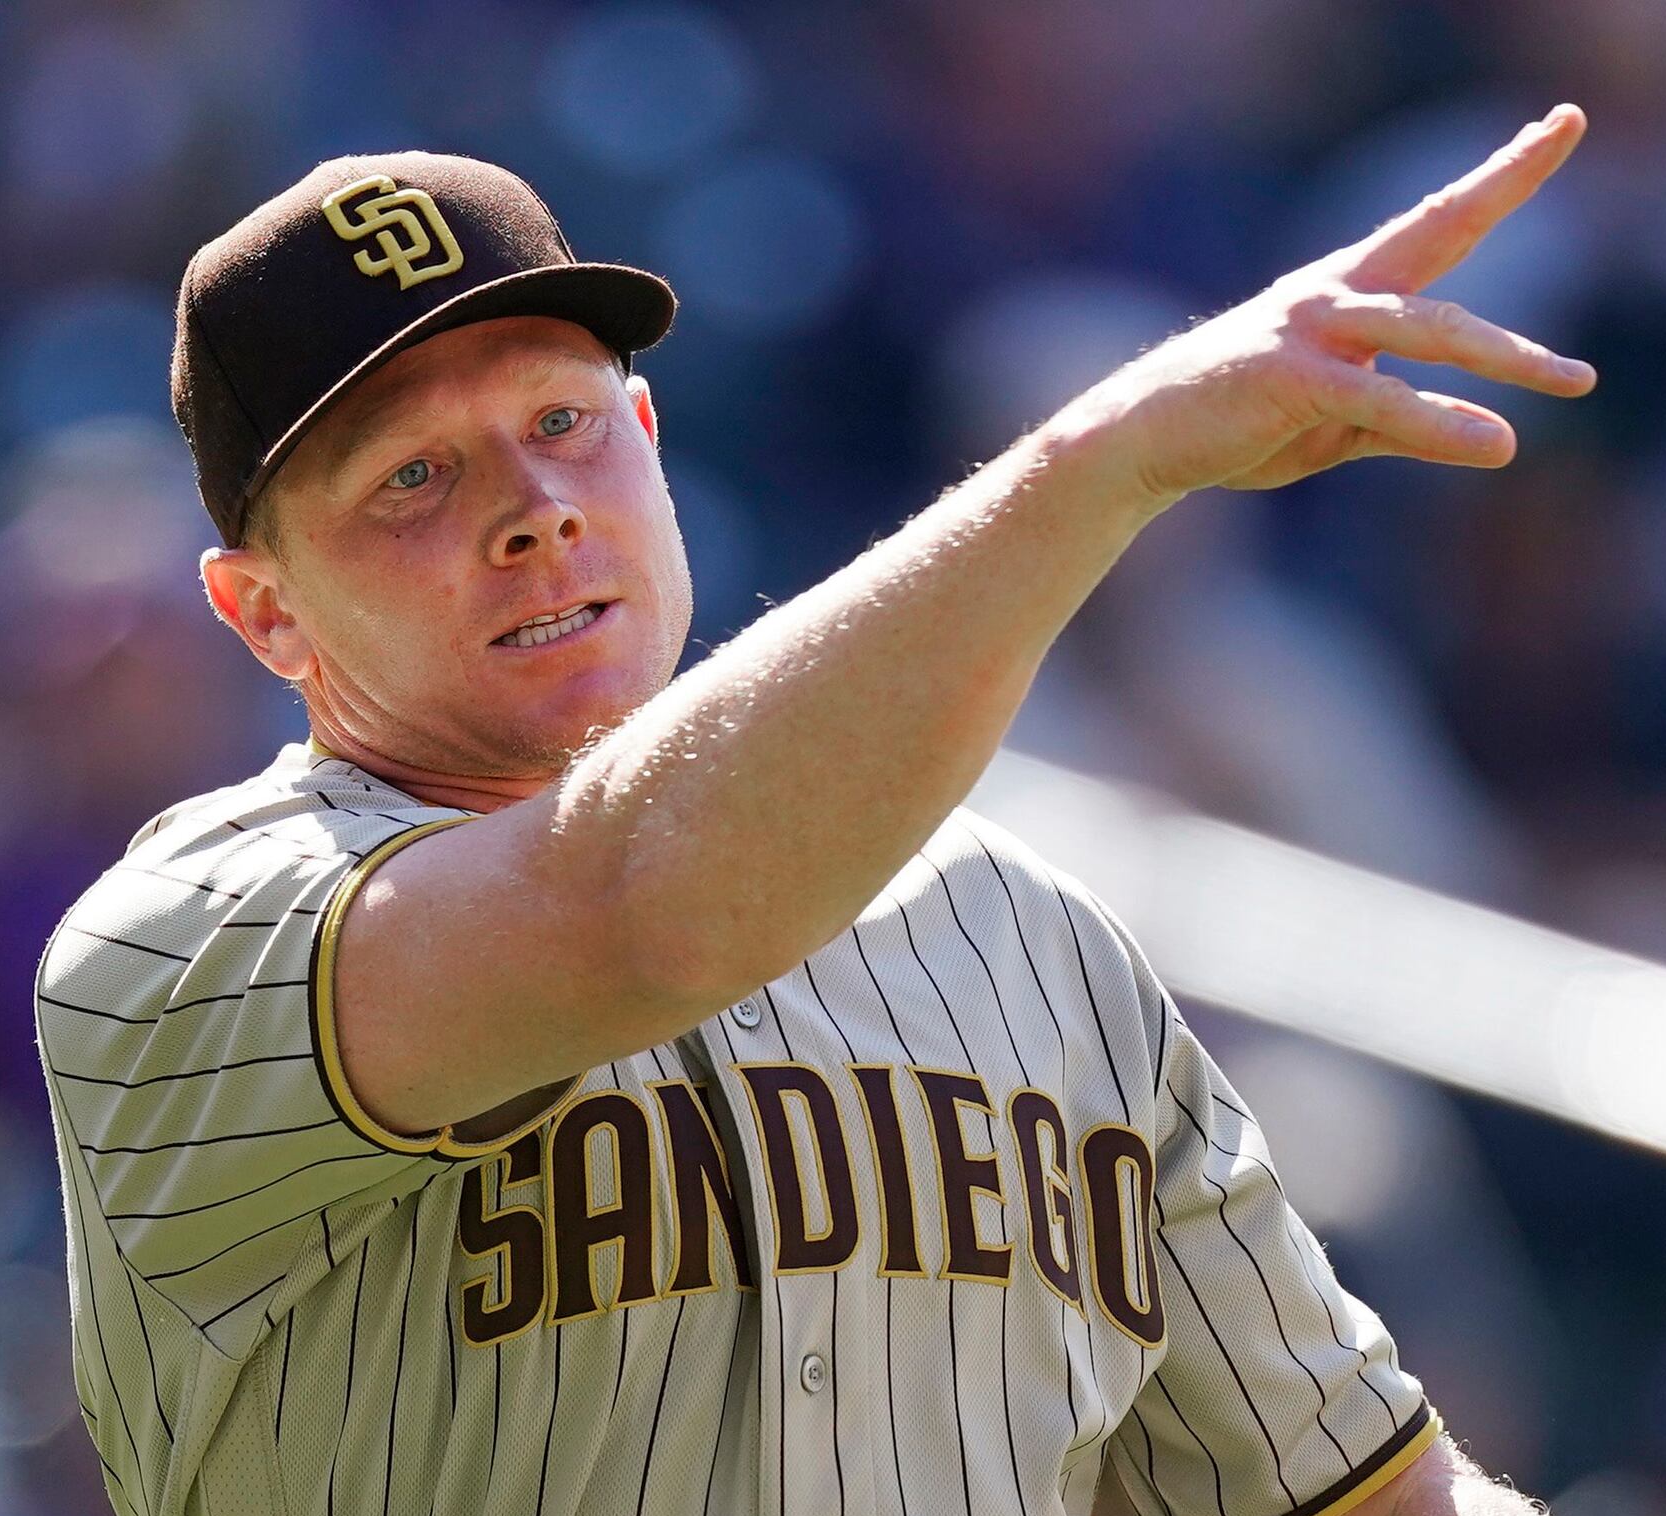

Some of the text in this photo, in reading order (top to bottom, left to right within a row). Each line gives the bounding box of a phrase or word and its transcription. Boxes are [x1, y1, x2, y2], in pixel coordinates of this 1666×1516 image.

[322, 174, 464, 290] SD
[457, 1060, 1167, 1349] SAN DIEGO
